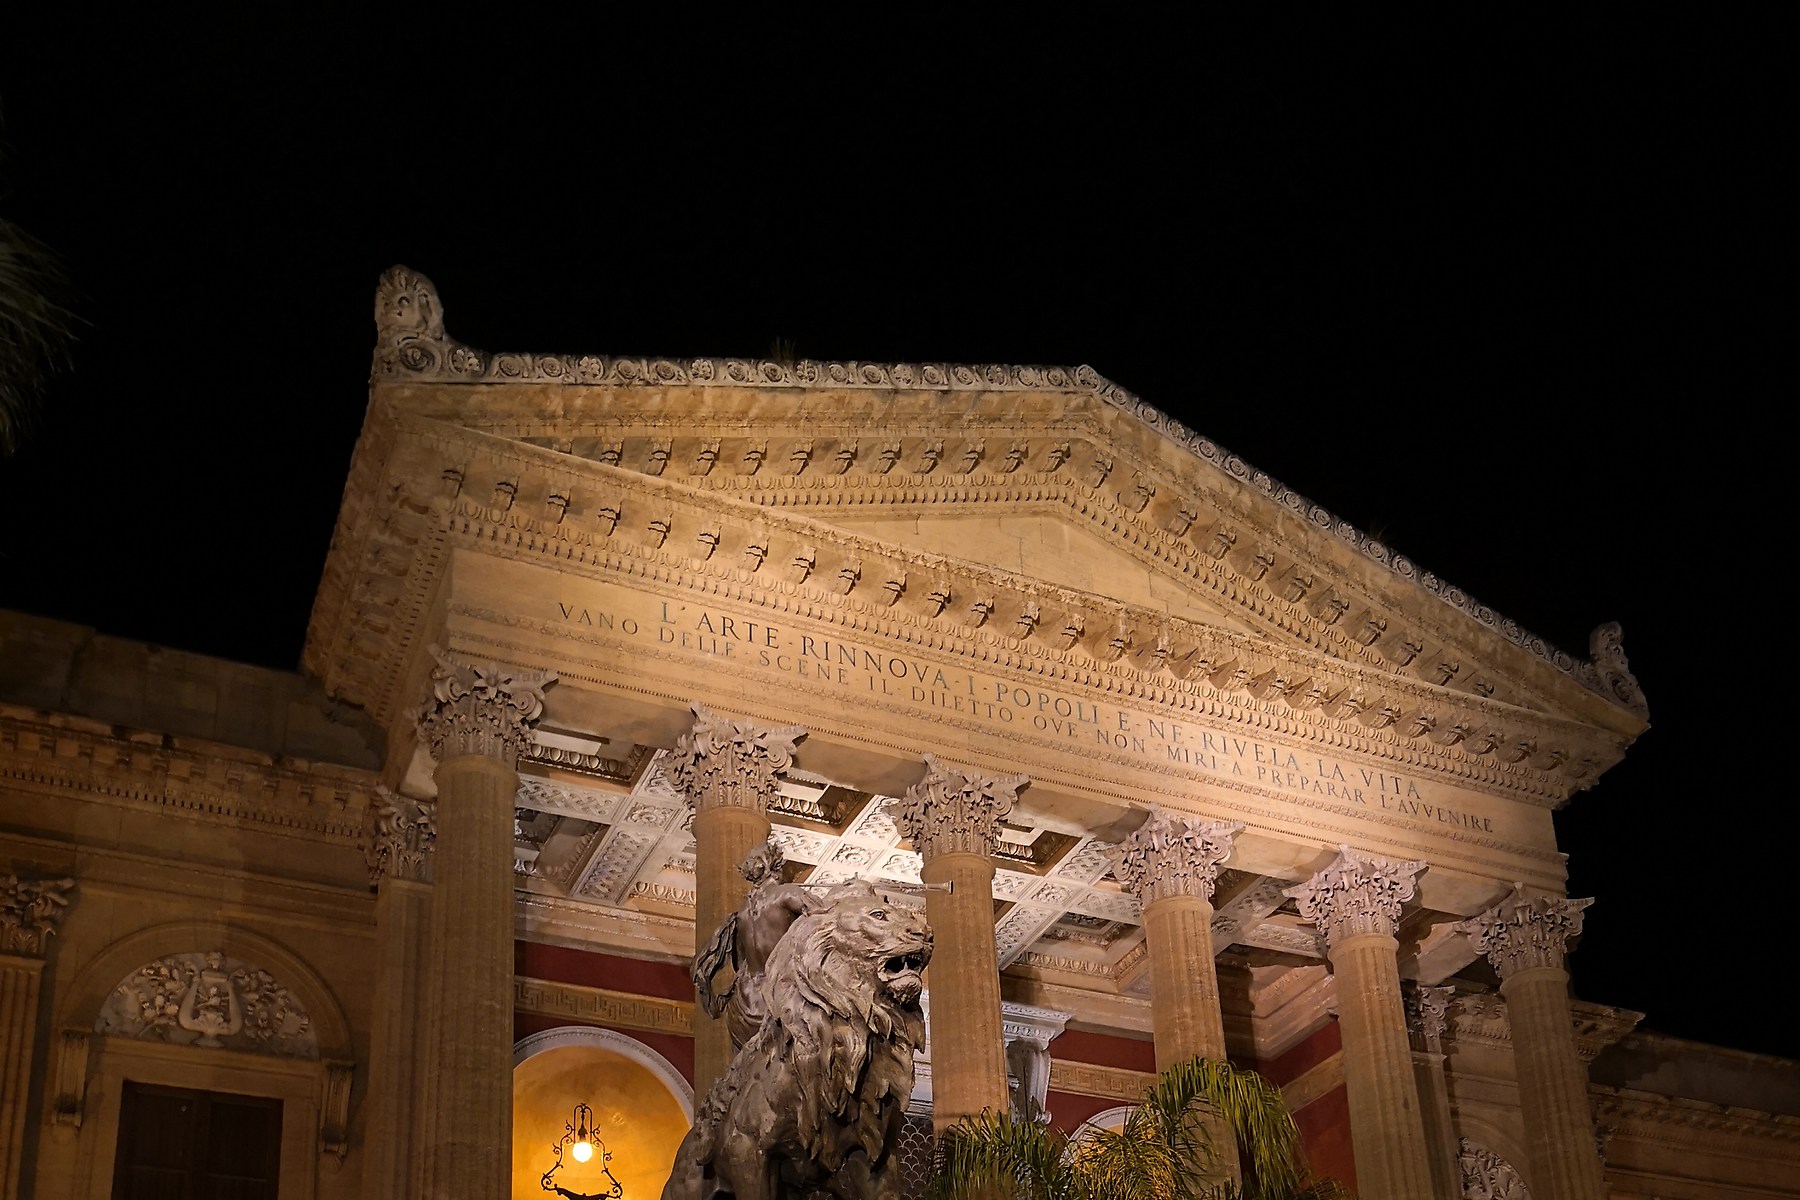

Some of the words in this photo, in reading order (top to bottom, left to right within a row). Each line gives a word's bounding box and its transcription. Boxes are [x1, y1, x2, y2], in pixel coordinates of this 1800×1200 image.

[558, 602, 638, 636] VANO
[659, 626, 737, 659] DELLE
[759, 650, 849, 686] SCENE
[869, 675, 894, 696] IL
[911, 686, 1014, 723] DILETTO
[1033, 714, 1079, 738] OVE
[1097, 730, 1145, 753] NON
[1166, 744, 1216, 770] MIRI
[1231, 761, 1243, 776] A
[1257, 765, 1367, 805] PREPARAR
[1380, 794, 1494, 834] L'AVVENIRE
[661, 601, 780, 650] L'ARTE
[801, 635, 950, 690] RINNOVA
[967, 675, 975, 696] I
[995, 682, 1099, 725] POPOLI
[1117, 711, 1131, 732] E
[1148, 718, 1184, 745] NE
[1202, 731, 1300, 771] RIVELA
[1317, 758, 1347, 783] LA
[1358, 768, 1422, 801] VITA
